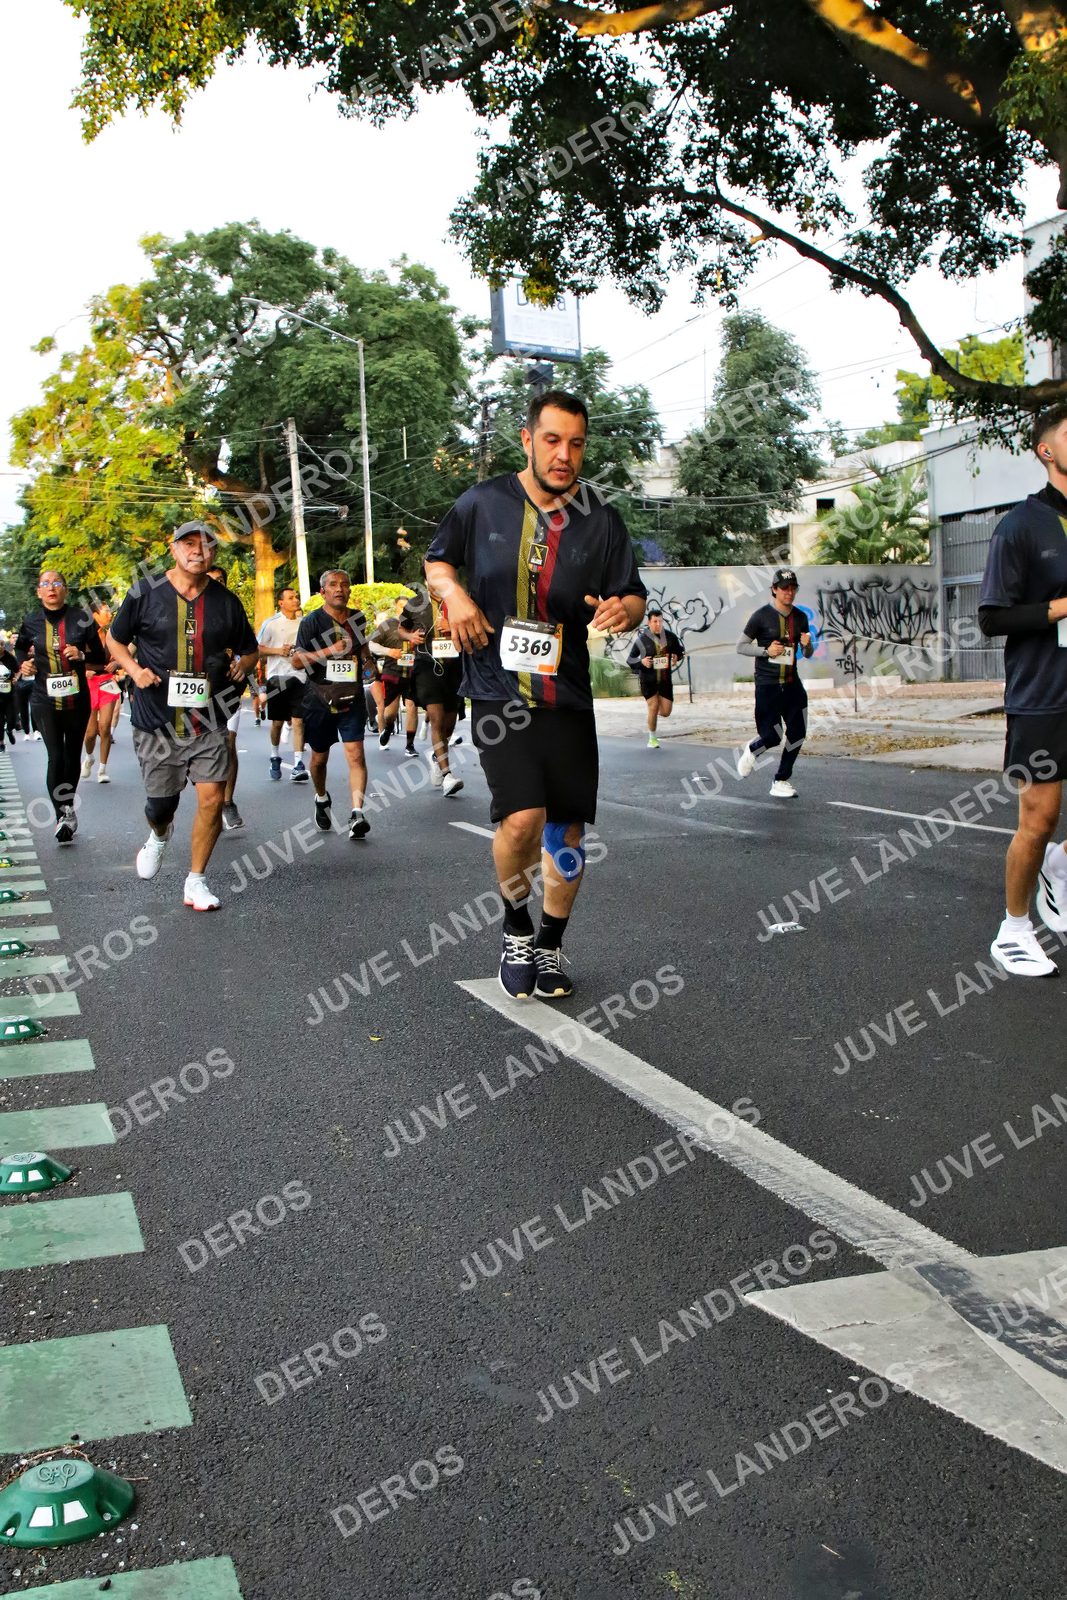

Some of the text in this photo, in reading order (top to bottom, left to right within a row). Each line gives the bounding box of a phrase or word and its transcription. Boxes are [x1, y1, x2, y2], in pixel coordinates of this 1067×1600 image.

[508, 635, 552, 656] 5369
[331, 663, 352, 672] 1353
[51, 680, 73, 689] 6804
[175, 682, 204, 695] 1296
